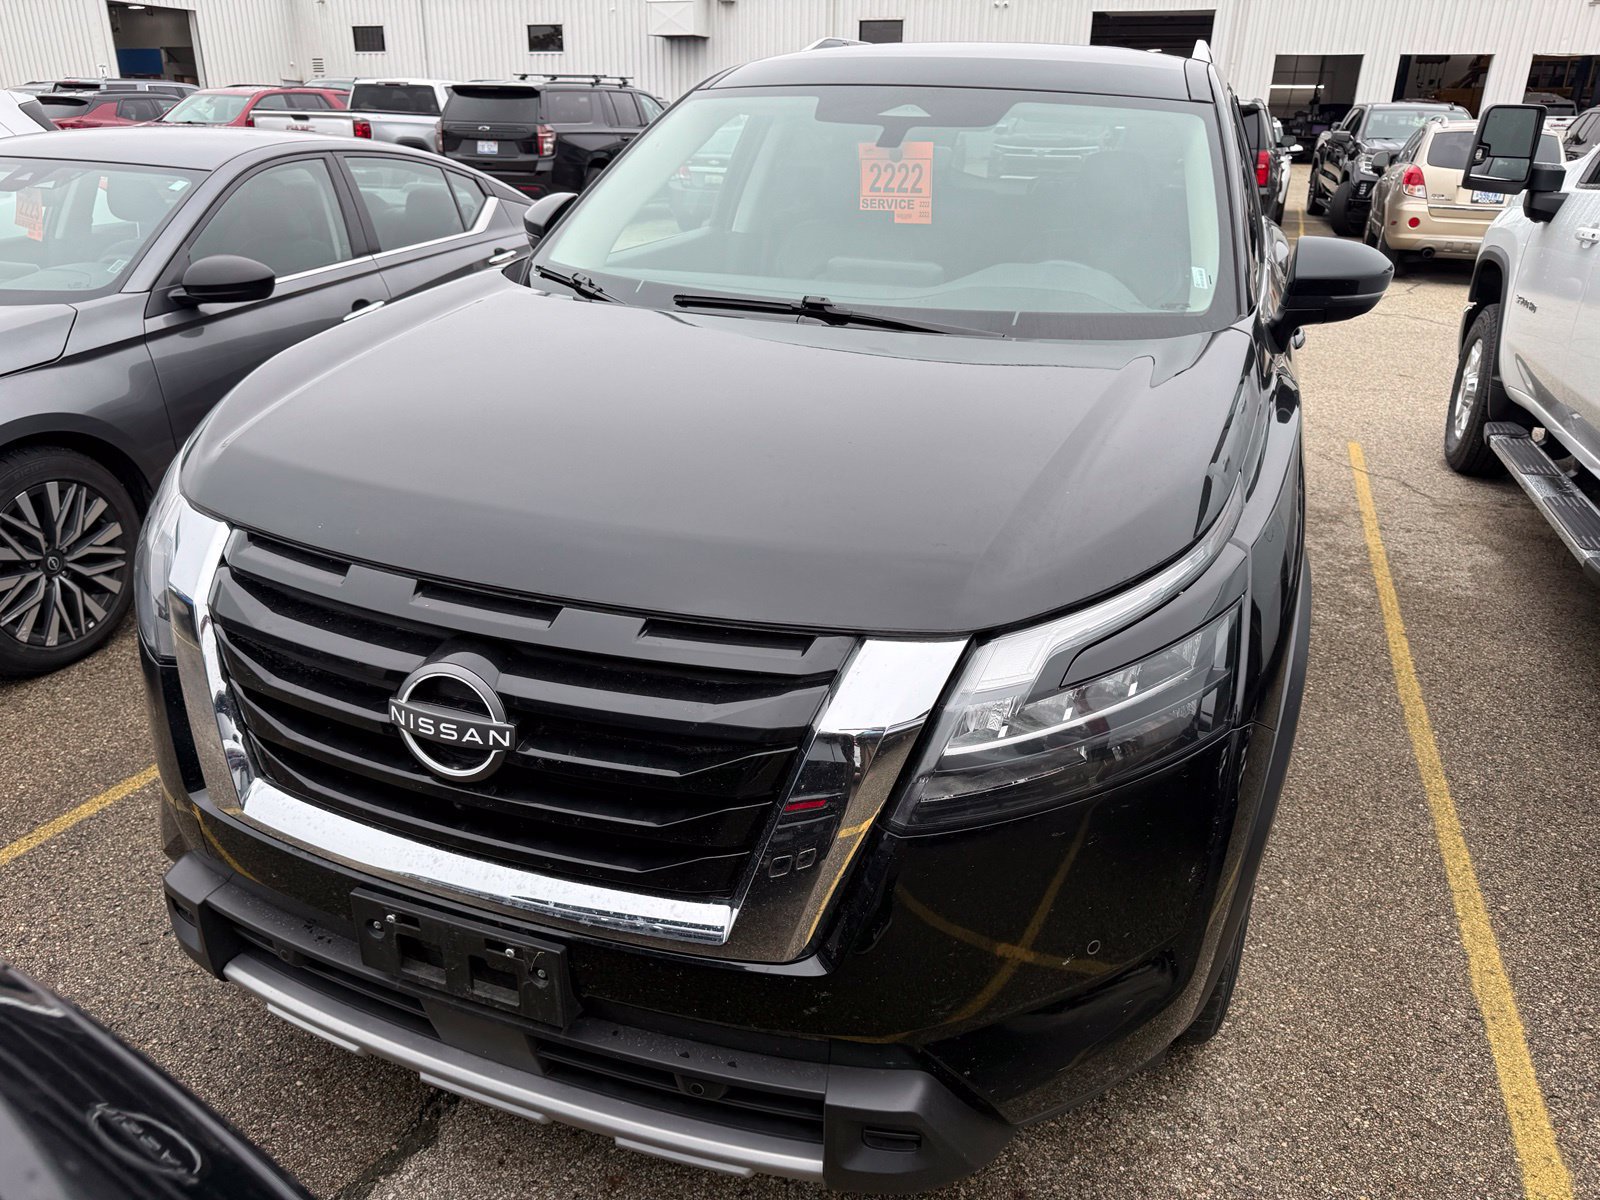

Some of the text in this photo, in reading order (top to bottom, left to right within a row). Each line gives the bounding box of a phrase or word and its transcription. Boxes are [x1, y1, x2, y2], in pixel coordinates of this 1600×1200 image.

[868, 162, 923, 194] 2222
[861, 198, 915, 210] SERVICE
[390, 705, 510, 747] NISSAN
